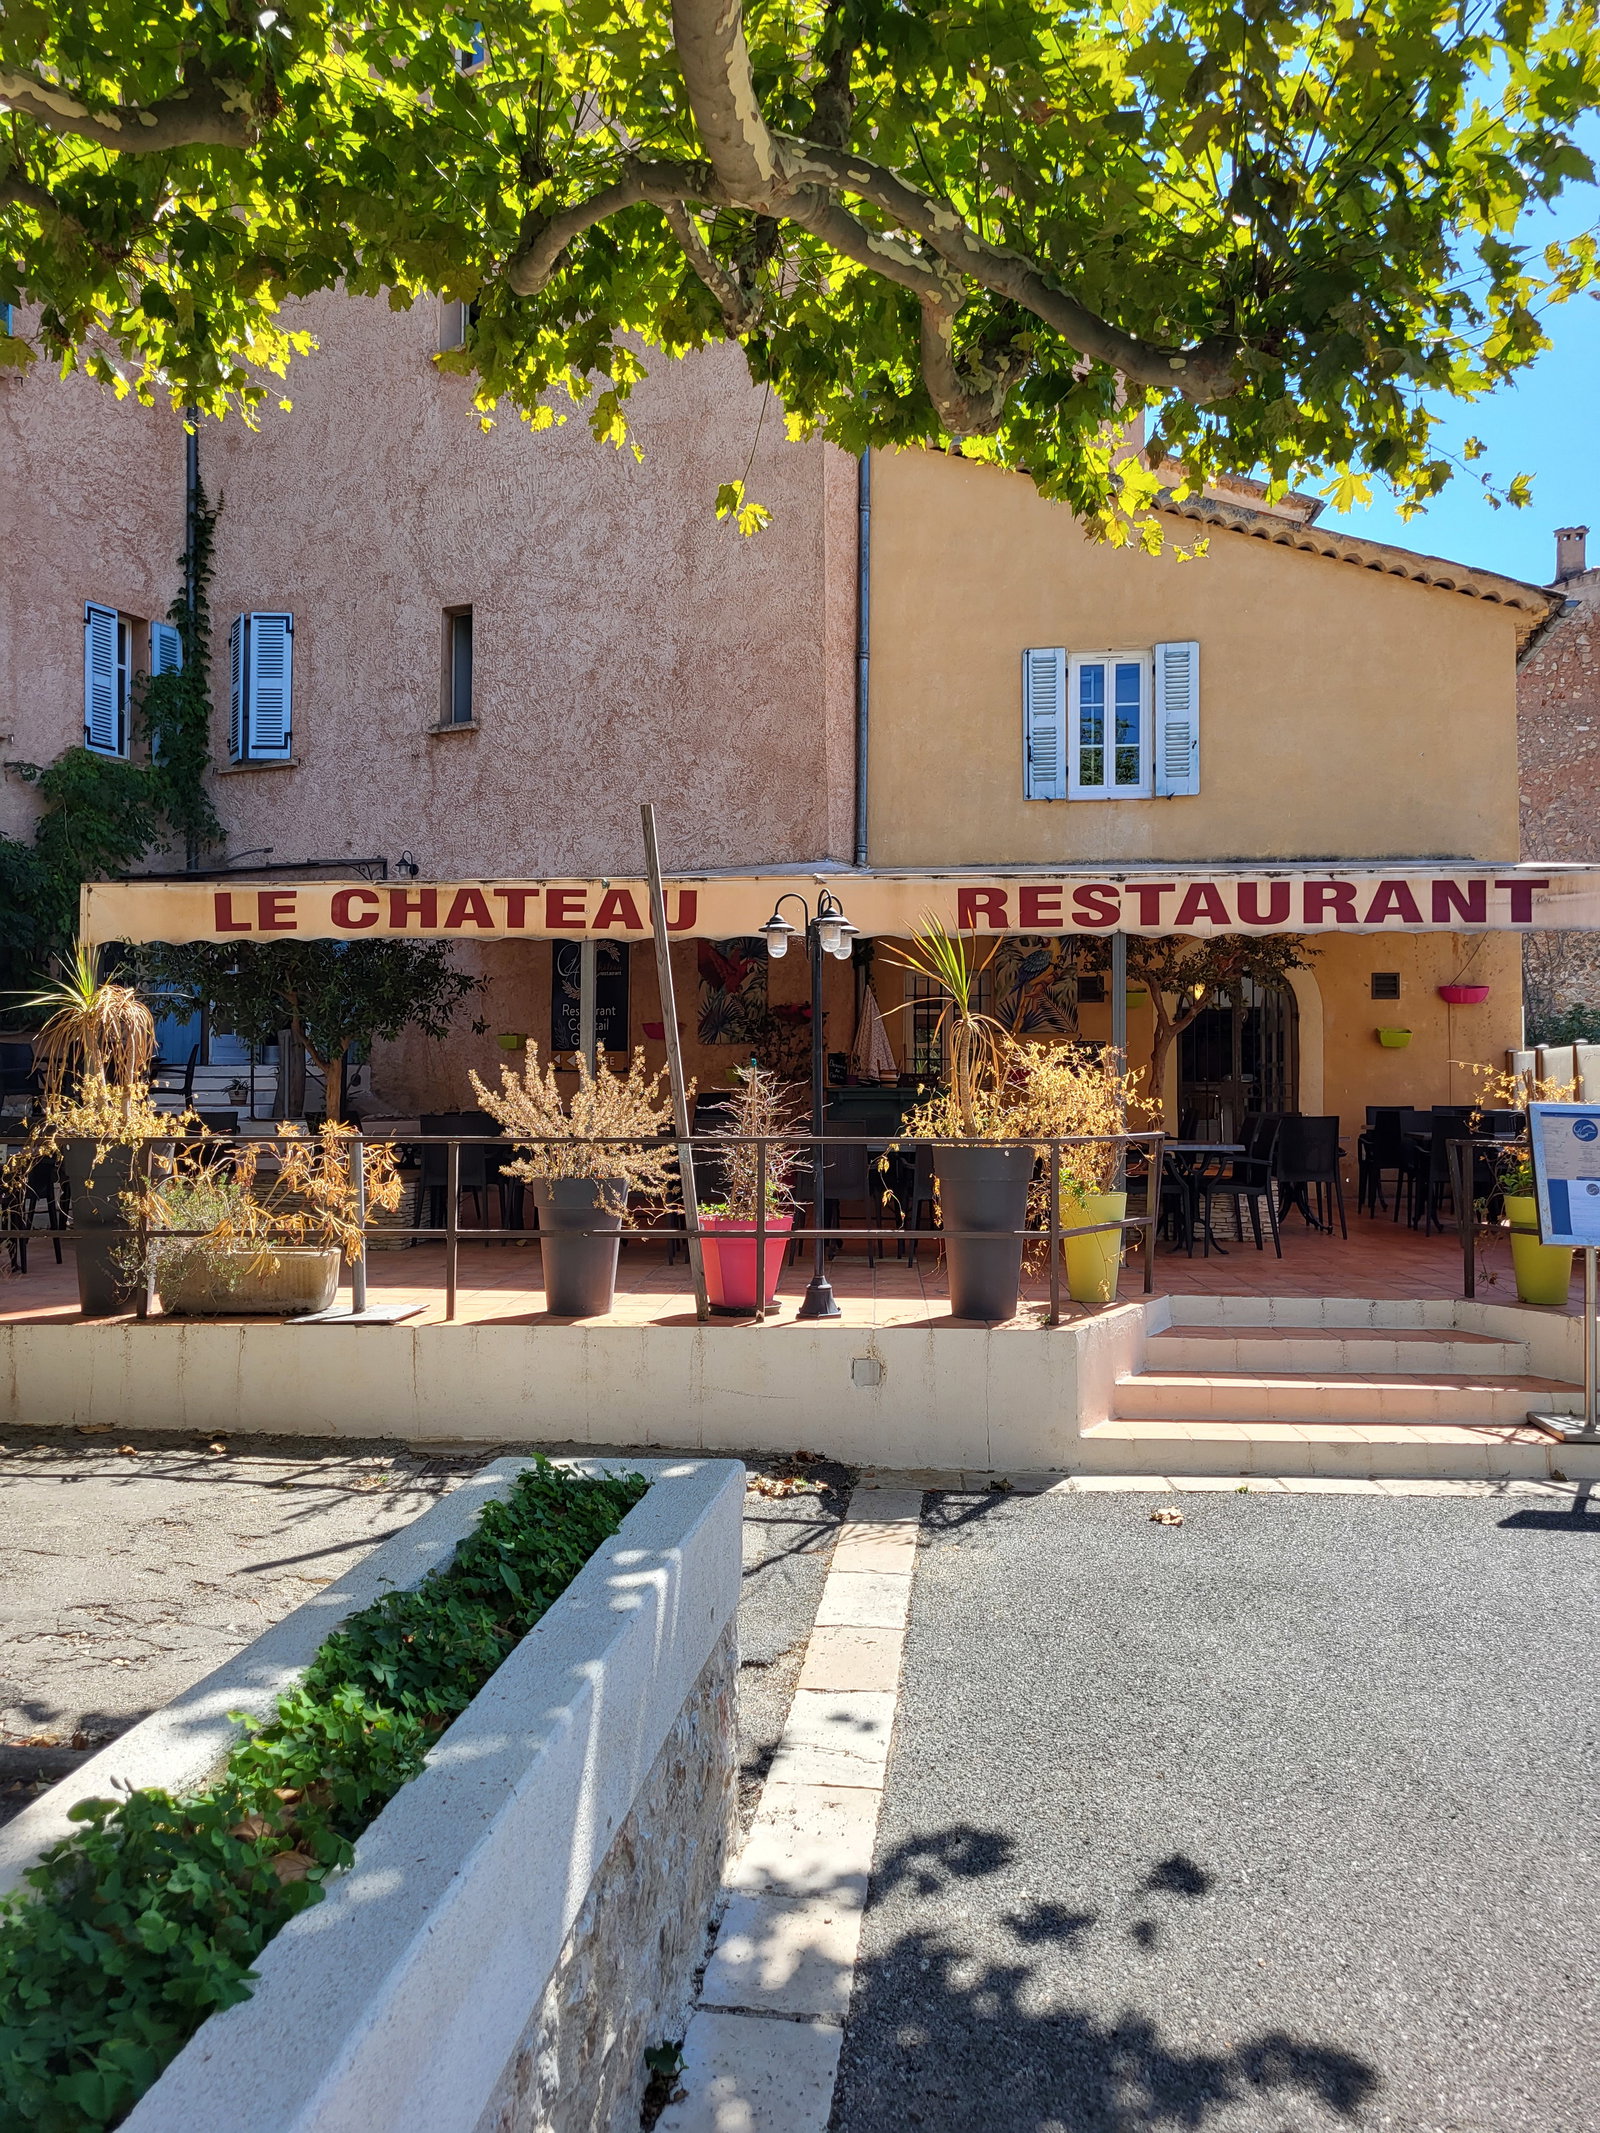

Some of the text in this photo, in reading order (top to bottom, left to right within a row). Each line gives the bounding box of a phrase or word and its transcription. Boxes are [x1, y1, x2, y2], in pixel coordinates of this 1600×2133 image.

[214, 888, 698, 932] LE CHATEAU
[957, 879, 1550, 930] RESTAURANT
[562, 1004, 616, 1016] Resrant
